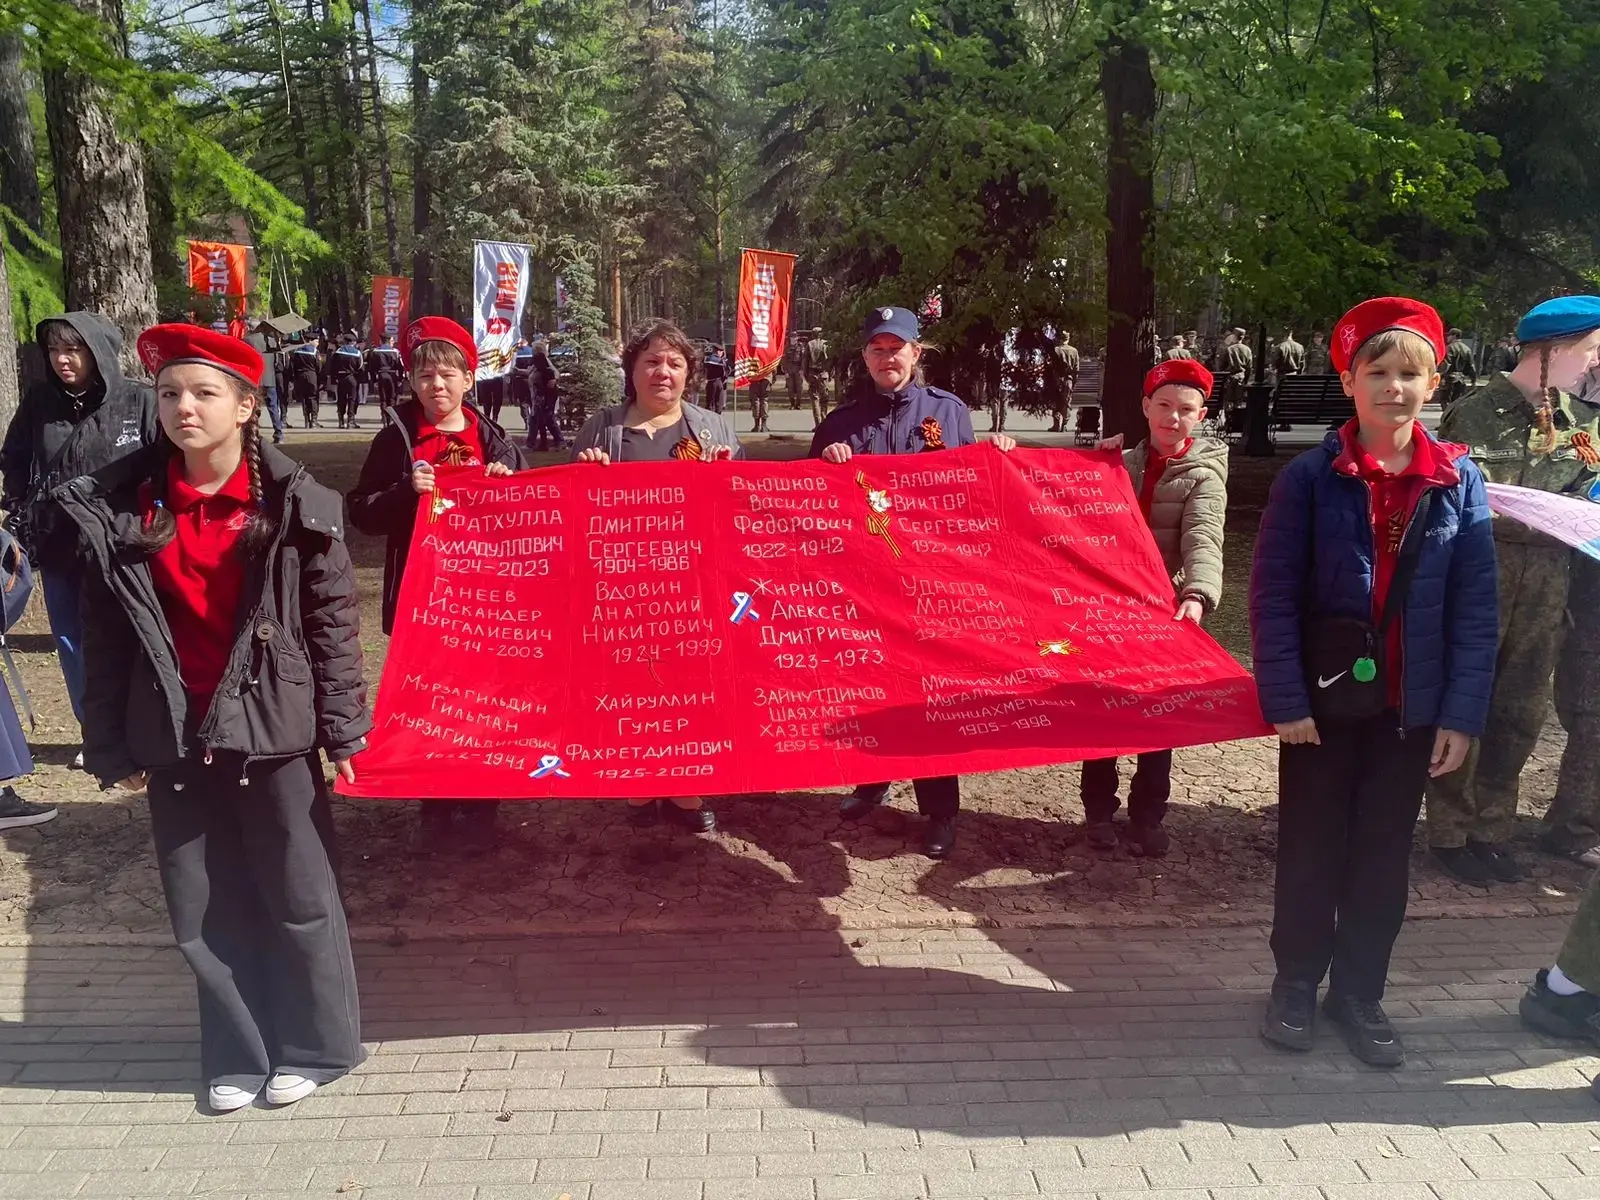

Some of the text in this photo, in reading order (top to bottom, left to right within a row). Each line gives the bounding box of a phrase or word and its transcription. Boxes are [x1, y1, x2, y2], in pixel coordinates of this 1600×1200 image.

[486, 262, 519, 335] 9 МАЯ
[751, 263, 776, 349] ПОБЕДА!
[731, 476, 828, 492] ВЬЮШКОВ
[888, 467, 978, 490] ЗАЛОМАЕВ
[1020, 466, 1103, 483] НЕСТЕРОВ
[588, 487, 685, 507] ЧЕРНИКОВ
[750, 494, 840, 512] Василий
[894, 493, 967, 512] ВИКТОР
[1042, 486, 1103, 500] АНТОН
[448, 509, 563, 533] ФАТХУЛЛА
[586, 510, 685, 537] ДМИТРИЙ
[733, 513, 853, 535] Федорович
[898, 516, 1000, 535] СЕРГЕЕВИЧ
[421, 534, 563, 557] АХМАДУЛЛОВИЧ
[588, 539, 702, 560] СЕРГЕЕВИЧ
[742, 537, 844, 559] 1922-1942
[440, 558, 549, 577] 1924-2023
[593, 556, 690, 574] 1904-1986
[433, 577, 517, 602] ГАНЕЕВ
[595, 580, 681, 601] ВДОВИН
[749, 577, 844, 597] ЖИРНОВ
[901, 575, 988, 598] УДАЛОВ
[429, 592, 542, 622] ИСКАНДЕР
[592, 595, 701, 622] АНАТОЛИЙ
[771, 599, 859, 622] АЛЕКСЕЙ
[916, 597, 1007, 615] МАКСИМ
[412, 607, 552, 641] НУРГАЛИЕВИЧ
[583, 618, 713, 644] НИКИТОВИЧ
[441, 635, 544, 658] 1914-2003
[759, 625, 883, 648] ДМИТРИЕВИЧ
[612, 638, 722, 664] 1924-1999
[774, 649, 884, 669] 1923-1973
[401, 674, 547, 715] МУРЗАГИЛЬДИН
[595, 691, 715, 712] ХАЙРУЛЛИН
[431, 695, 518, 733] ГИЛЬМАН
[768, 705, 858, 722] ШАЯХМЕТ
[618, 717, 689, 736] ГУМЕР
[760, 720, 860, 738] ХАЗЕЕВИЧ
[958, 714, 1052, 736] 1905-1998
[565, 739, 733, 761] ФАХРЕТДИНОВИЧ
[592, 764, 714, 779] 1925-2008
